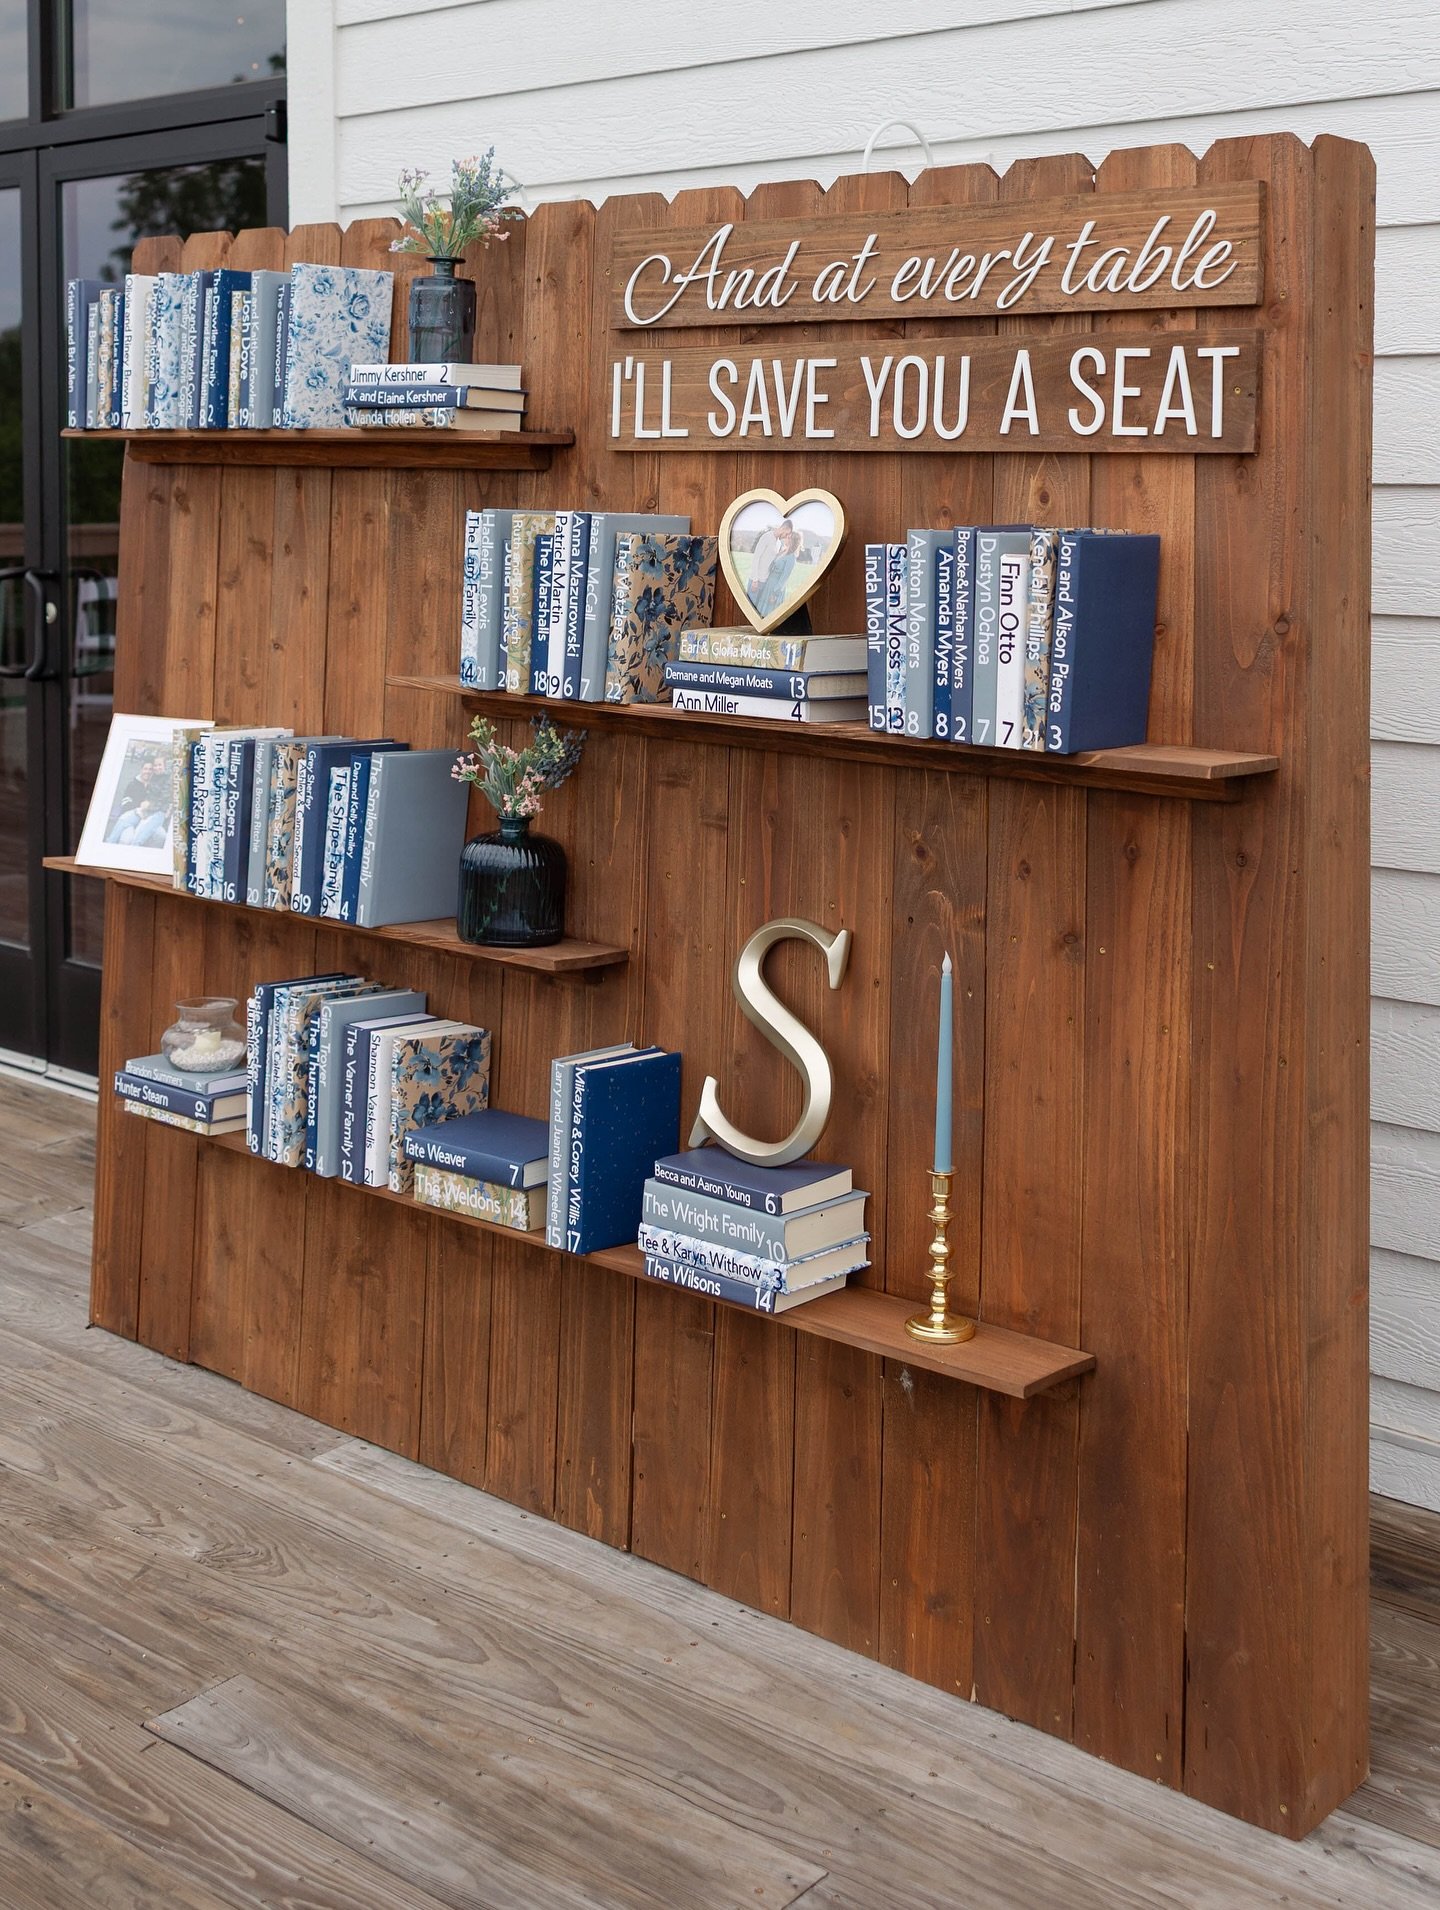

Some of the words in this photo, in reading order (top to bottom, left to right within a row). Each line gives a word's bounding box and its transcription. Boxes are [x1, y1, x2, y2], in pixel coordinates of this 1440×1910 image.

[214, 269, 222, 294] The
[252, 272, 260, 294] Joe
[624, 224, 800, 325] And
[812, 234, 879, 302] at
[891, 232, 1051, 308] every
[1061, 210, 1240, 295] table
[68, 282, 76, 323] Kristian
[126, 277, 134, 309] Olivia
[212, 296, 220, 347] Detwiler
[242, 296, 251, 334] Josh
[68, 325, 76, 344] and
[123, 335, 132, 367] Riney
[249, 322, 259, 365] Kaitlyn
[274, 310, 284, 388] Greenwoods
[68, 347, 76, 362] Bri
[209, 350, 218, 387] Family
[240, 338, 251, 380] Dove
[124, 369, 132, 408] Brown
[248, 368, 258, 408] Fowler
[352, 367, 383, 386] Jimmy
[384, 365, 427, 382] Kershner
[440, 366, 448, 383] 2
[612, 356, 689, 439] I'LL
[707, 358, 837, 439] SAVE
[861, 355, 971, 440] YOU
[1000, 349, 1040, 435] A
[1067, 346, 1240, 438] SEAT
[208, 404, 214, 422] 2
[346, 388, 358, 401] JK
[360, 390, 376, 402] and
[378, 392, 404, 404] Elaine
[406, 391, 447, 404] Kershner
[456, 388, 462, 406] 1
[68, 410, 76, 428] 16
[87, 410, 94, 427] 5
[240, 408, 248, 426] 19
[272, 408, 280, 426] 18
[468, 517, 480, 543] The
[482, 514, 494, 580] Hadleigh
[554, 516, 568, 566] Patrick
[571, 514, 584, 556] Anna
[590, 515, 604, 554] Isaac
[467, 547, 478, 578] Lam
[540, 538, 552, 567] The
[618, 537, 632, 568] The
[910, 536, 926, 598] Ashton
[979, 538, 997, 602] Dustyn
[1031, 532, 1051, 598] Kendall
[1060, 537, 1076, 567] Jon
[584, 567, 600, 620] McCall
[889, 546, 908, 608] Susan
[938, 550, 954, 626] Amanda
[1001, 562, 1020, 606] Finn
[1058, 572, 1074, 602] and
[463, 583, 478, 630] Family
[479, 584, 492, 630] Lewis
[538, 570, 552, 642] Marshalls
[552, 573, 566, 624] Martin
[567, 560, 584, 658] Mazurowski
[613, 572, 630, 640] Metzlers
[889, 614, 907, 670] Moss
[908, 602, 926, 669] Moyers
[978, 608, 996, 666] Ochoa
[1000, 612, 1020, 664] Otto
[1026, 600, 1048, 661] Phillips
[1055, 606, 1074, 660] Alison
[476, 667, 486, 684] 21
[935, 631, 953, 687] Myers
[534, 671, 547, 692] 18
[563, 676, 574, 697] 6
[580, 678, 590, 699] 7
[606, 682, 620, 700] 22
[666, 667, 698, 682] Demane
[700, 672, 714, 684] and
[716, 674, 744, 689] Megan
[746, 675, 773, 690] Moats
[790, 677, 806, 699] 13
[1050, 658, 1070, 713] Pierce
[676, 692, 702, 710] Ann
[704, 694, 739, 714] Miller
[791, 702, 802, 722] 4
[868, 705, 886, 728] 15
[908, 711, 919, 734] 8
[936, 713, 948, 736] 8
[954, 716, 966, 741] 2
[978, 718, 990, 743] 7
[1002, 721, 1014, 744] 7
[1023, 730, 1040, 749] 21
[1049, 725, 1062, 750] 3
[228, 743, 242, 788] Hillary
[352, 762, 362, 780] Dan
[371, 758, 383, 785] The
[335, 771, 348, 801] The
[351, 782, 359, 800] and
[226, 790, 240, 838] Rogers
[330, 806, 344, 848] Shipe
[349, 801, 358, 825] Kelly
[365, 788, 380, 836] Smiley
[346, 826, 356, 858] Smiley
[326, 852, 342, 904] Family
[360, 840, 375, 888] Family
[223, 882, 236, 902] 16
[340, 902, 350, 920] 4
[310, 1018, 320, 1047] The
[321, 1006, 332, 1038] Gina
[346, 1029, 358, 1056] The
[688, 917, 853, 1168] S
[320, 1043, 331, 1086] Troyer
[554, 1063, 564, 1098] Larry
[308, 1052, 320, 1126] Thurstons
[344, 1060, 356, 1108] Varner
[573, 1067, 586, 1124] Mikayla
[555, 1099, 563, 1123] and
[250, 1134, 259, 1153] 8
[340, 1110, 354, 1157] Family
[553, 1125, 564, 1168] Juanita
[572, 1128, 582, 1139] &
[306, 1148, 314, 1168] 5
[316, 1156, 324, 1176] 4
[342, 1160, 353, 1182] 12
[364, 1168, 374, 1185] 21
[405, 1137, 425, 1158] Tate
[427, 1144, 466, 1168] Weaver
[510, 1165, 520, 1186] 7
[569, 1140, 583, 1184] Corey
[551, 1172, 562, 1226] Wheeler
[568, 1188, 582, 1226] Willis
[655, 1166, 679, 1182] Becca
[680, 1173, 696, 1188] and
[697, 1178, 722, 1196] Aaron
[724, 1184, 751, 1206] Young
[764, 1193, 776, 1214] 6
[547, 1225, 562, 1248] 15
[567, 1230, 581, 1253] 17
[644, 1191, 668, 1218] The
[671, 1199, 718, 1234] Wright
[722, 1216, 766, 1248] Family
[766, 1239, 786, 1262] 10
[640, 1232, 658, 1252] Tee
[662, 1238, 670, 1254] &
[673, 1240, 706, 1266] Karyn
[709, 1254, 762, 1281] Withrow
[774, 1268, 782, 1290] 3
[646, 1256, 670, 1280] The
[672, 1264, 721, 1296] Wilsons
[755, 1288, 772, 1312] 14
